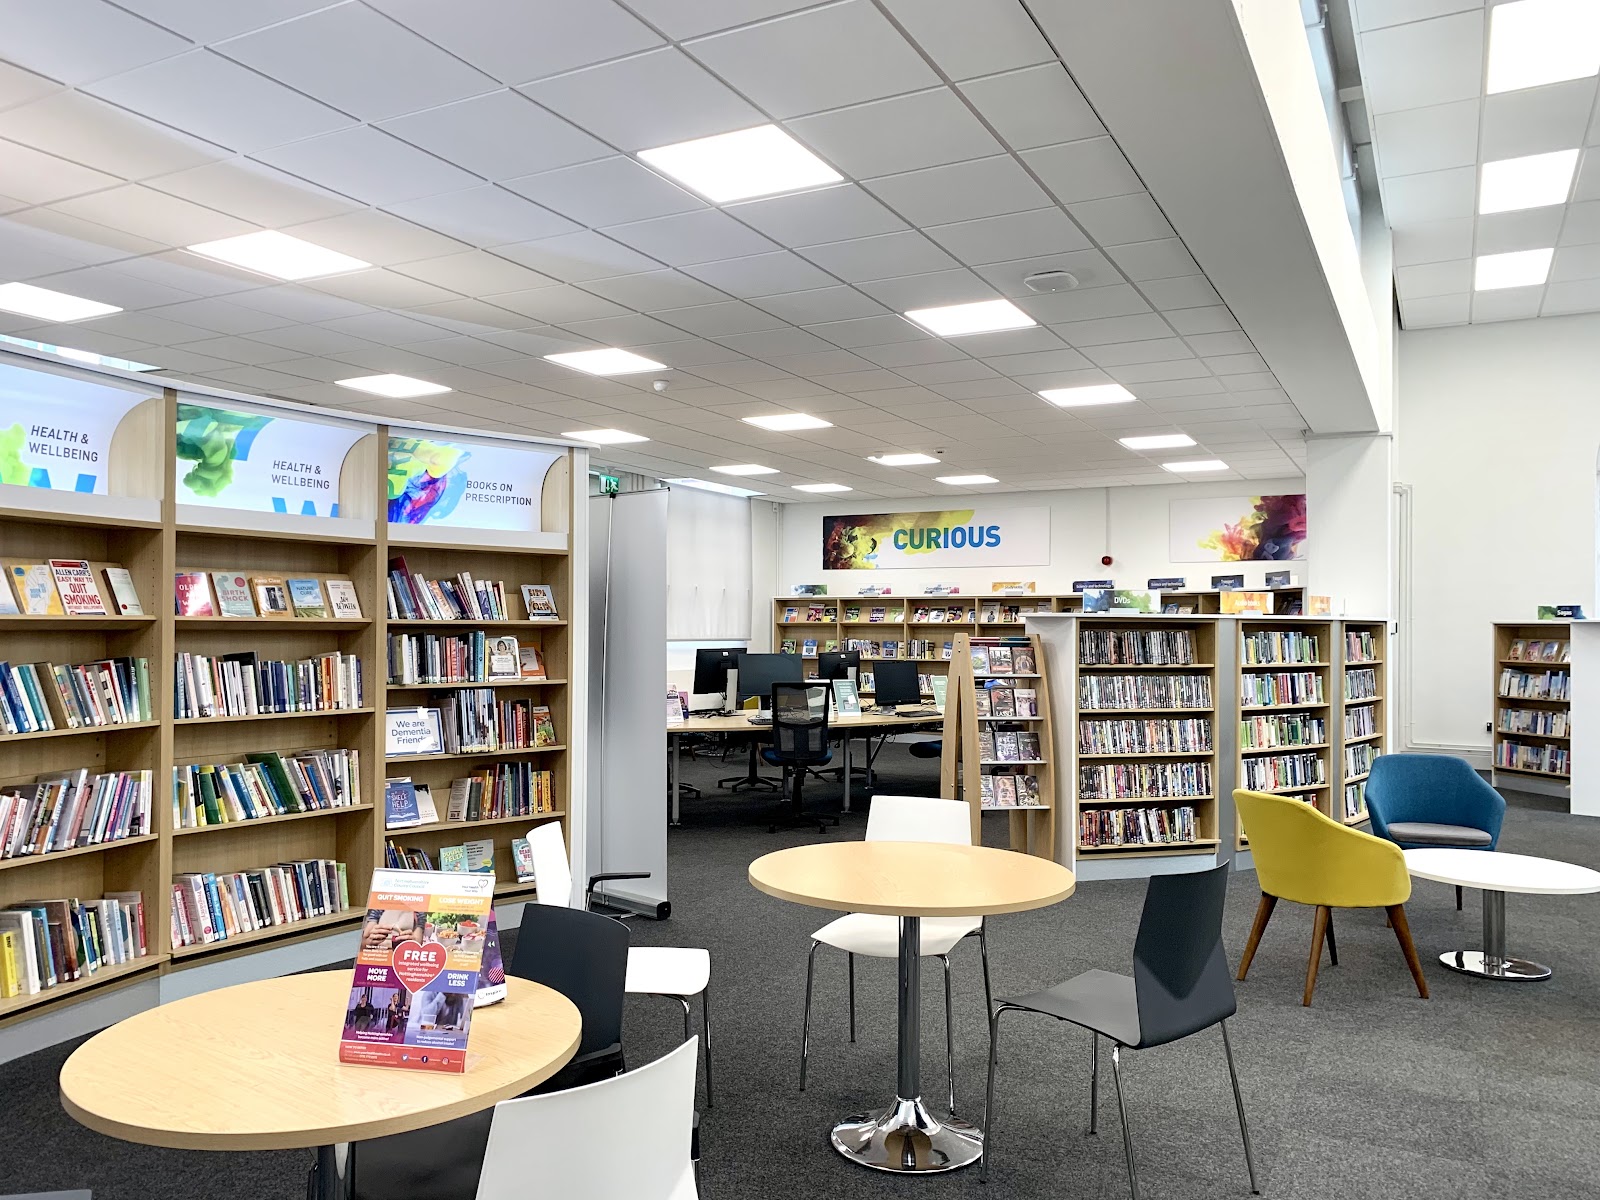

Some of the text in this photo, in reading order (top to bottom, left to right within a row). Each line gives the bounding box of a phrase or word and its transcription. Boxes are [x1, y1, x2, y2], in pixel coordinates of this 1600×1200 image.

[30, 425, 89, 444] HEALTH &
[28, 441, 99, 462] WELLBEING
[272, 460, 322, 475] HEALTH &
[271, 474, 330, 490] WELLBEING
[466, 480, 513, 492] BOOKS ON
[465, 493, 532, 506] PRESCRIPTION
[893, 525, 1001, 550] CURIOUS
[55, 568, 73, 577] ALLEN
[69, 583, 88, 594] QUIT
[63, 594, 101, 605] SMOKING
[1113, 596, 1131, 604] DVDs
[1556, 609, 1573, 617] Sagas
[395, 720, 411, 728] We
[391, 728, 432, 737] Dementia
[396, 736, 426, 745] Friend
[391, 800, 409, 809] HELP
[377, 893, 393, 901] QUIT
[393, 894, 424, 903] SMOKING
[403, 950, 437, 962] FREE
[368, 967, 388, 976] MOVE
[366, 974, 387, 982] MORE
[447, 972, 469, 981] DRINK
[448, 979, 466, 987] LESS
